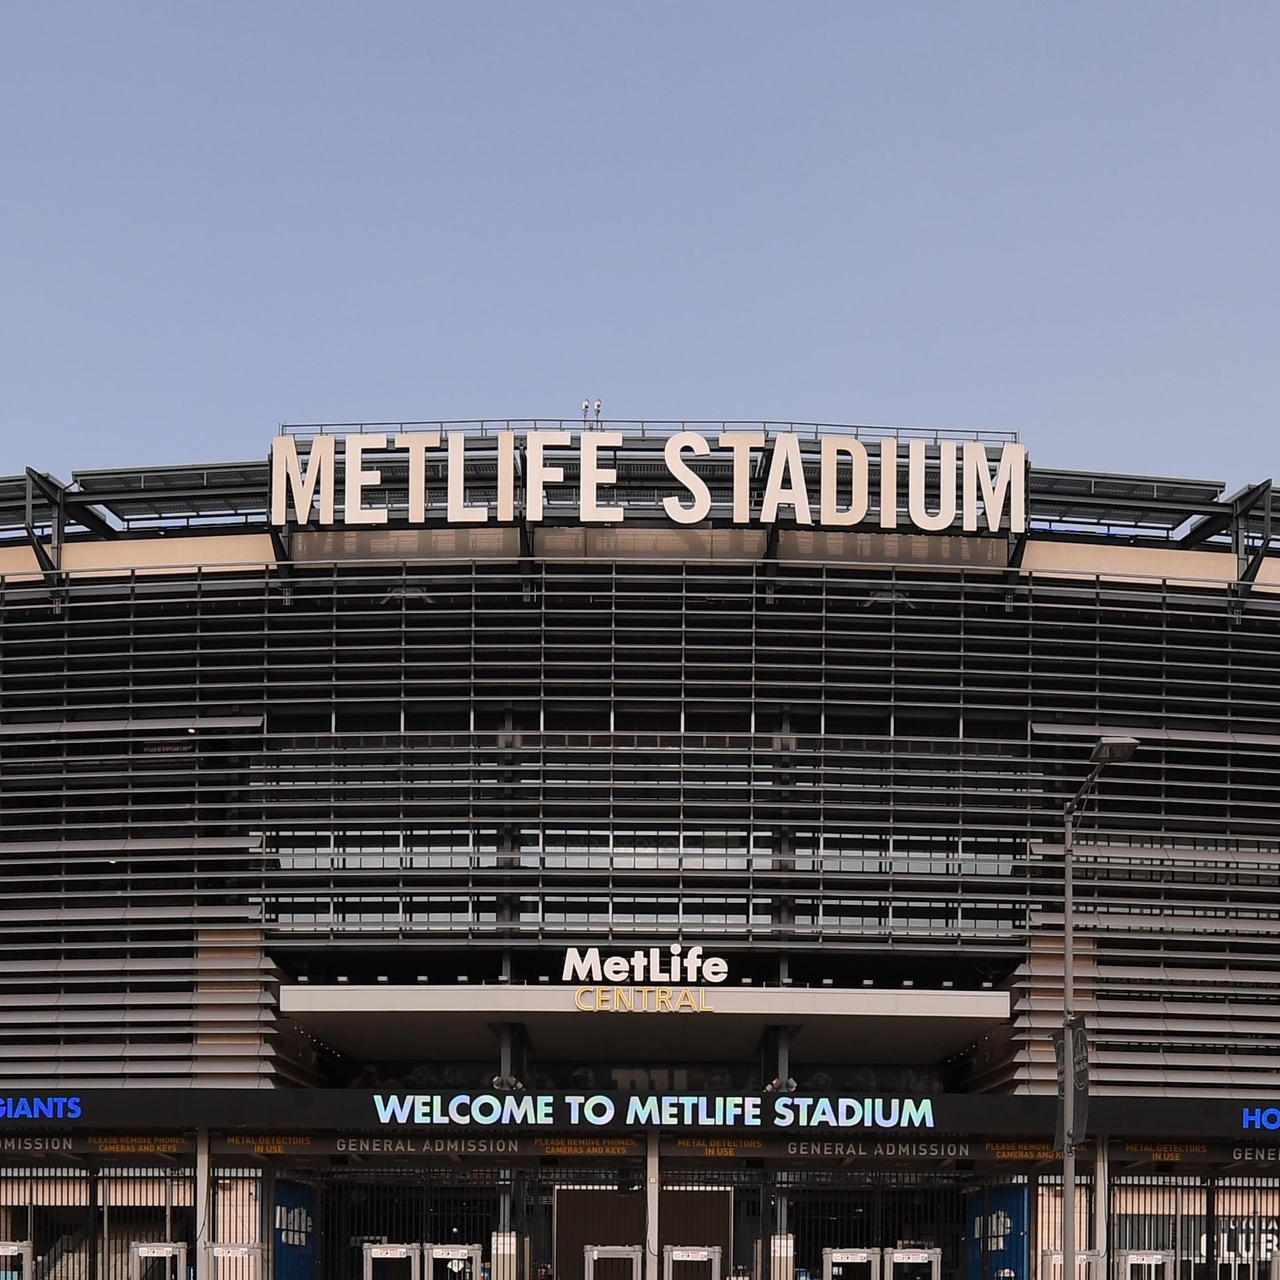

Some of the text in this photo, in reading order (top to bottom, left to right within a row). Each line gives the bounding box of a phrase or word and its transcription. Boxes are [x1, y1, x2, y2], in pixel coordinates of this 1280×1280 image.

[271, 431, 1026, 534] METLIFE STADIUM
[562, 943, 729, 983] MetLife
[574, 986, 714, 1012] CENTRAL
[373, 1095, 935, 1127] WELCOME TO METLIFE STADIUM
[259, 1137, 311, 1145] DETECTORS
[677, 1139, 762, 1147] METAL DETECTORS
[98, 1144, 135, 1152] CAMERAS
[138, 1144, 154, 1152] AND
[254, 1145, 284, 1153] IN USE
[336, 1139, 519, 1152] GENERAL ADMISSION
[787, 1142, 970, 1156] GENERAL ADMISSION
[1018, 1143, 1051, 1151] REMOVE
[545, 1146, 584, 1154] CAMERAS
[705, 1148, 735, 1156] IN USE
[996, 1151, 1034, 1159] CAMERAS
[1163, 1153, 1181, 1161] USE
